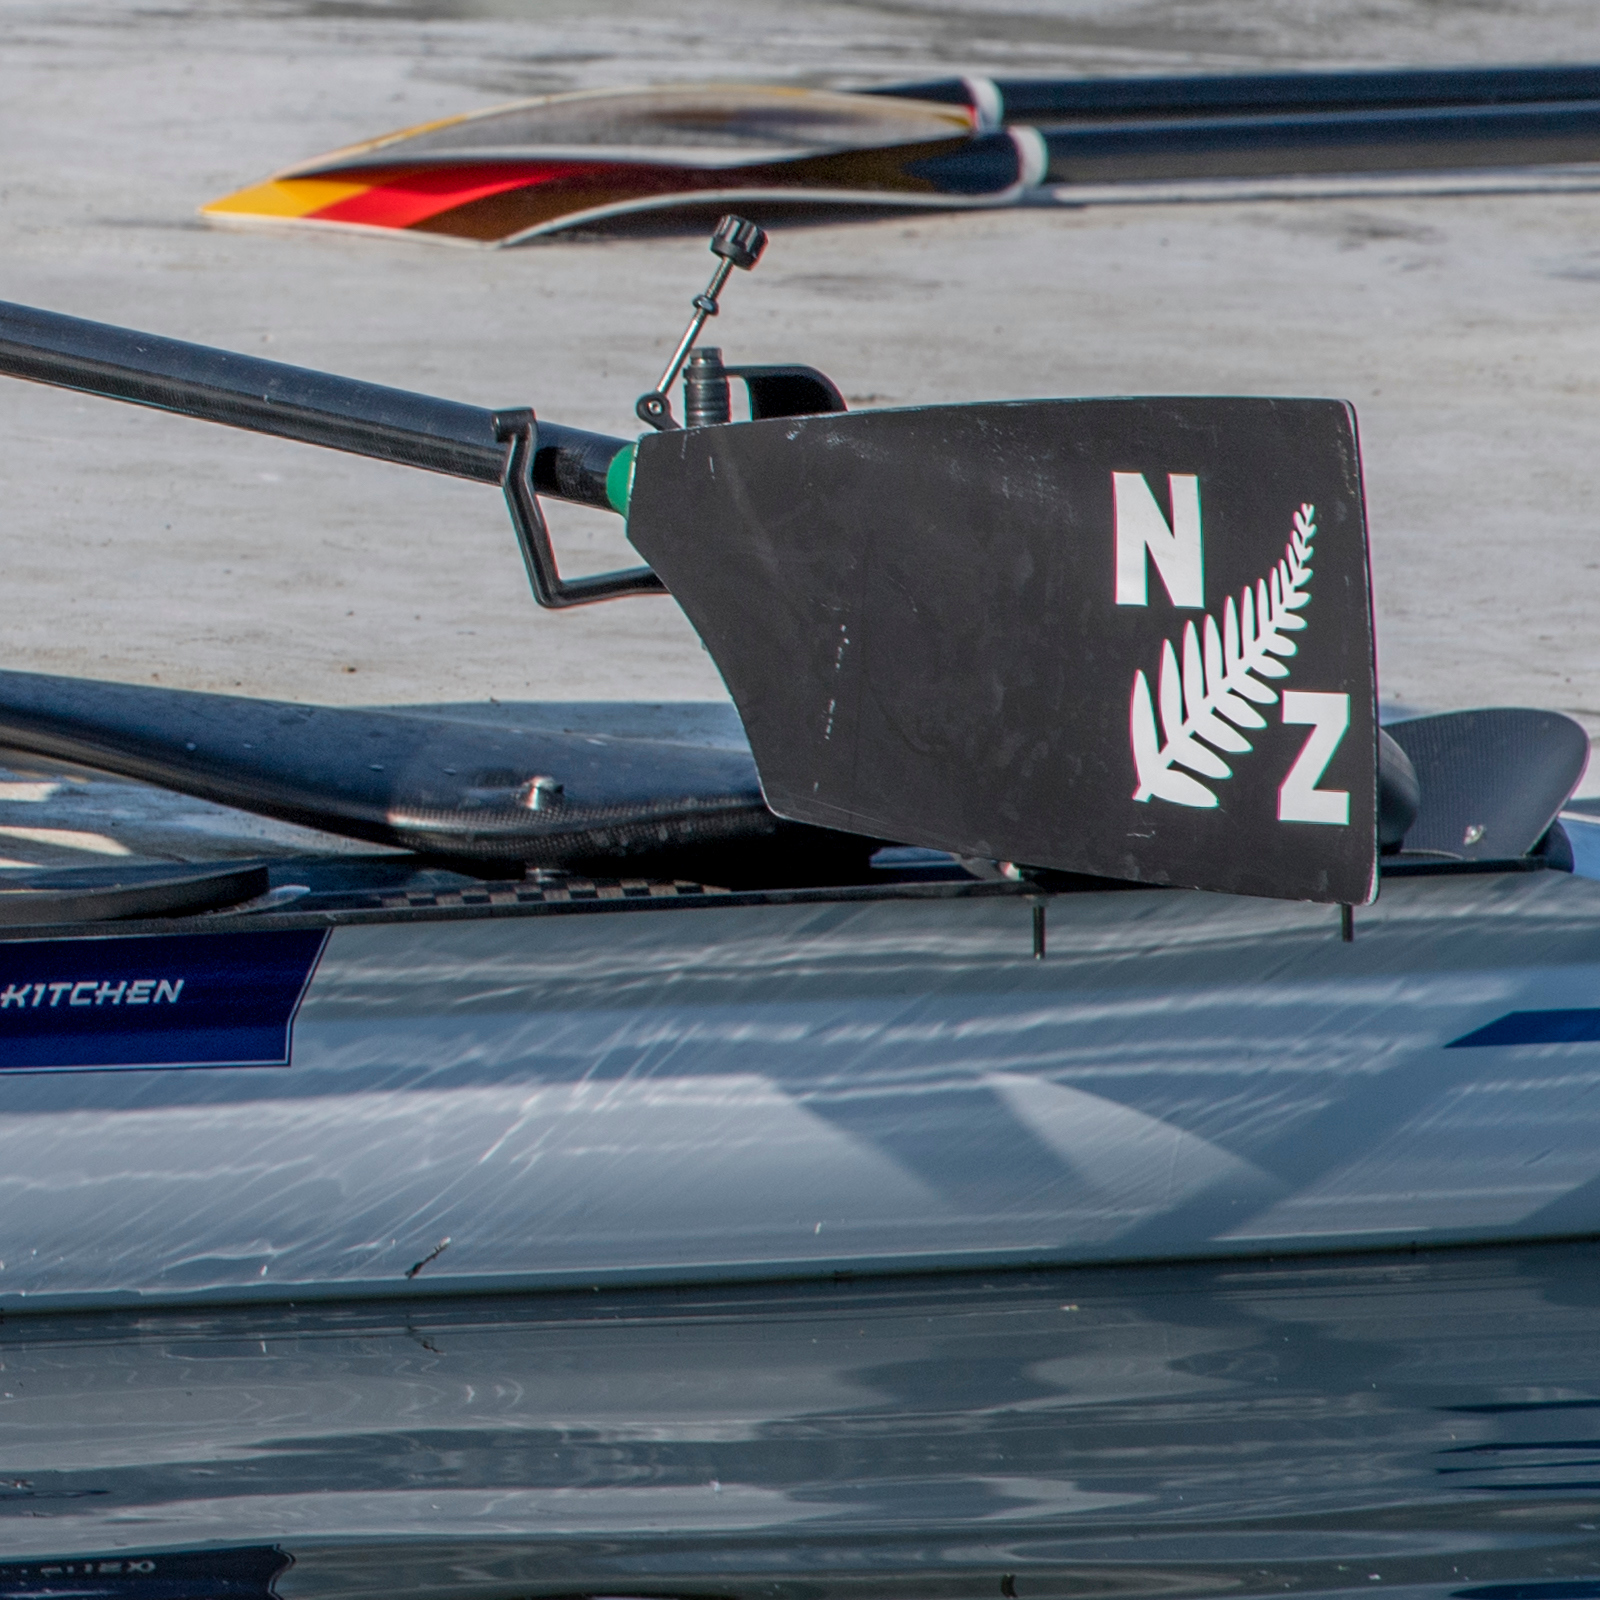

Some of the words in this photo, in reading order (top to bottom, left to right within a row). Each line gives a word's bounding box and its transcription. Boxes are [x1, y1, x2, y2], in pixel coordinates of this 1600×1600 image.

[1112, 470, 1205, 609] N
[1277, 688, 1350, 825] Z
[0, 979, 185, 1008] KITCHEN
